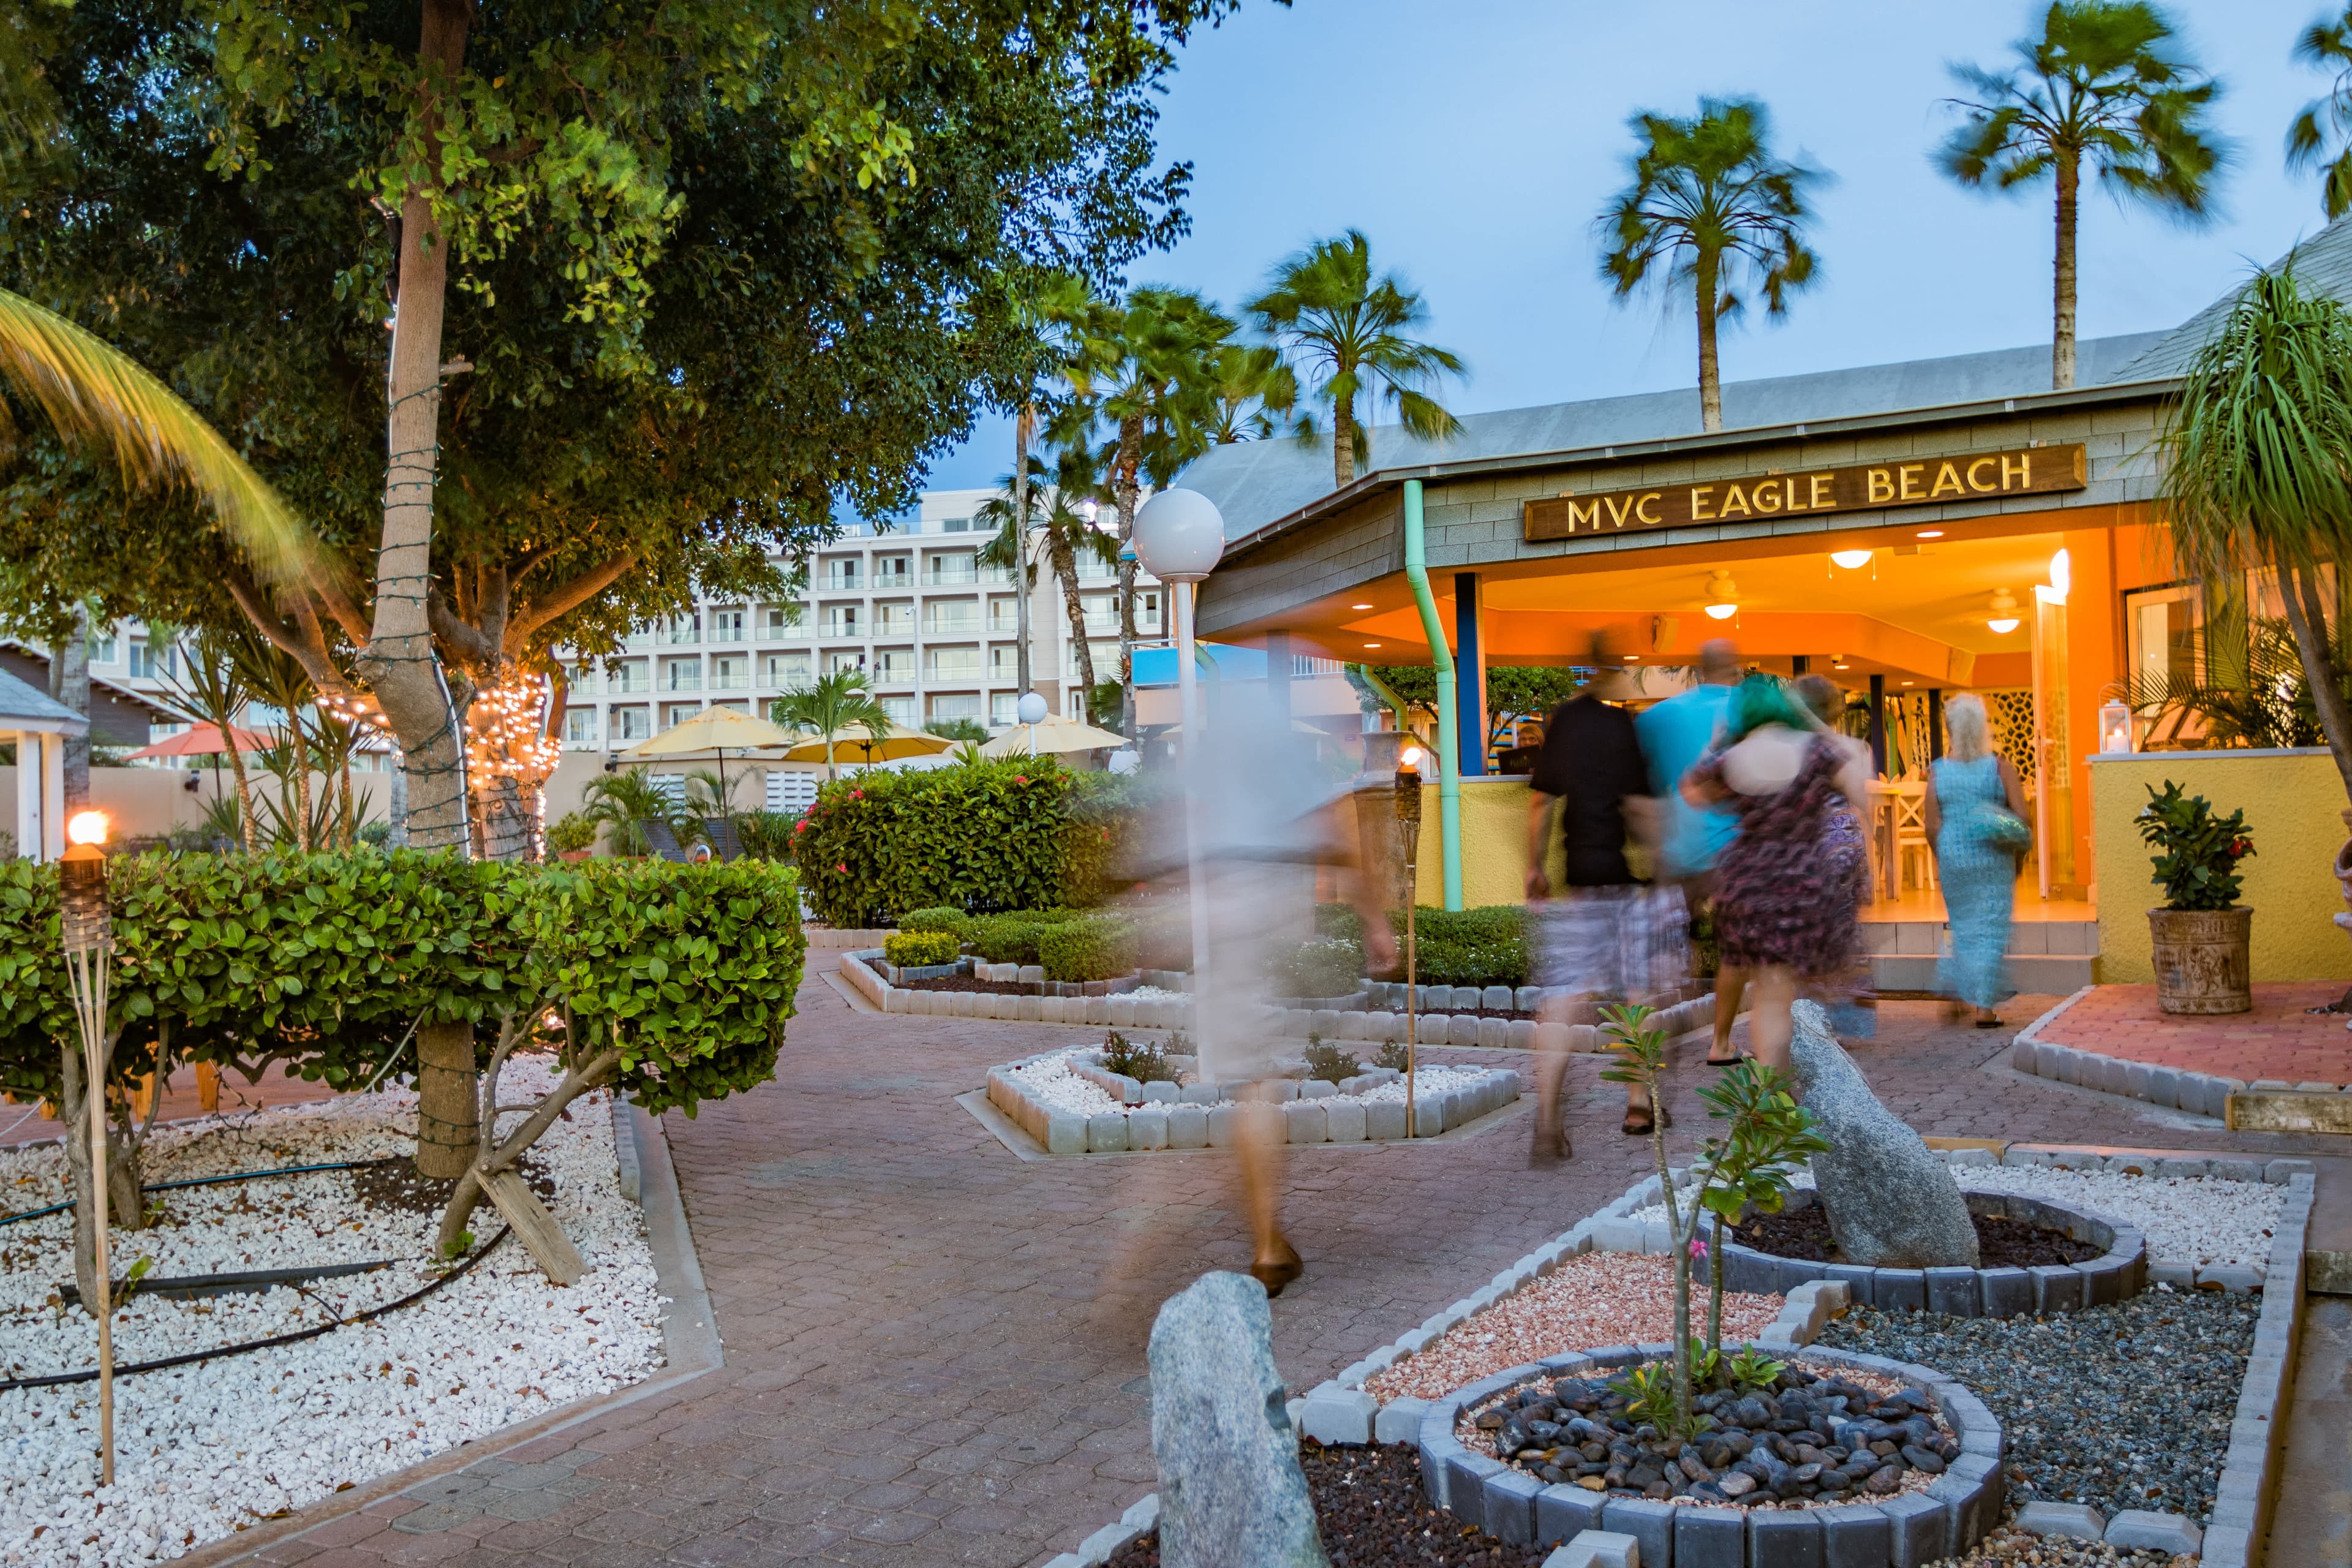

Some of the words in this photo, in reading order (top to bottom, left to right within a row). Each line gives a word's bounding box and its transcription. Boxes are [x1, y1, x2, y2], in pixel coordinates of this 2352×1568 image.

[1568, 492, 1662, 532] MVC
[1692, 473, 1836, 520] EAGLE
[1868, 453, 2030, 503] BEACH
